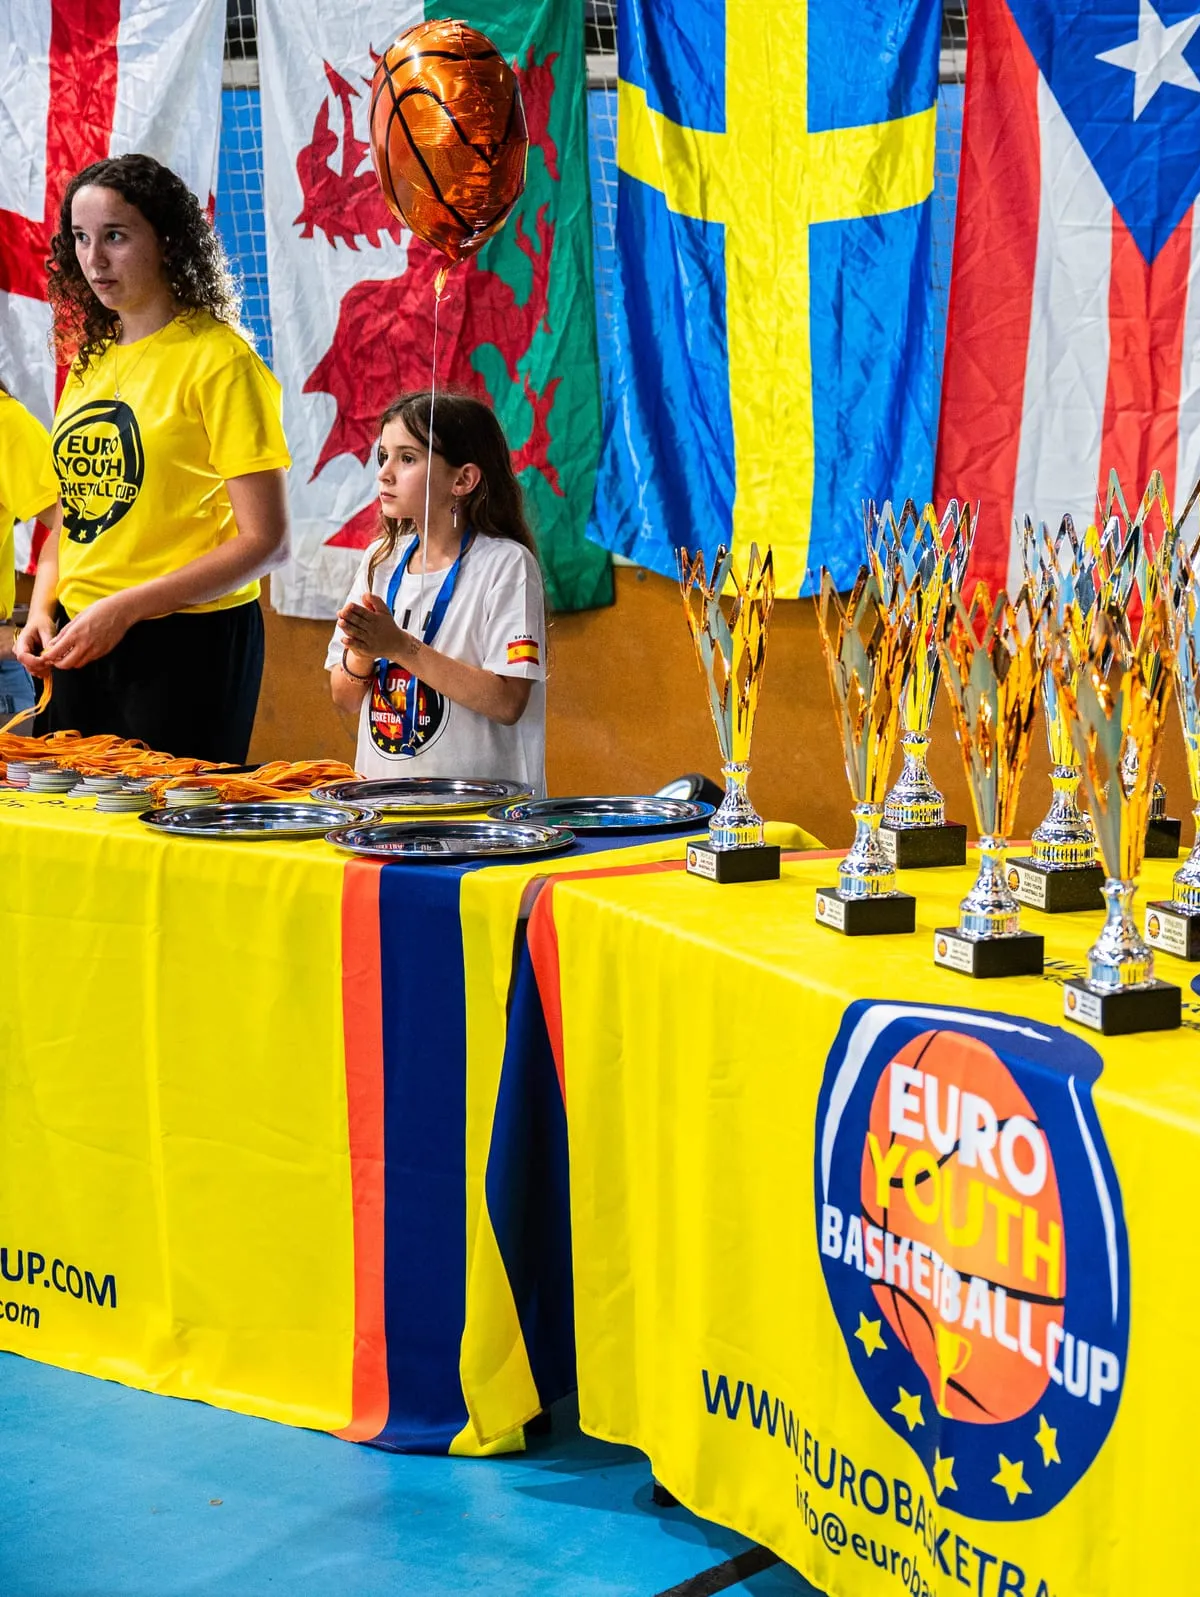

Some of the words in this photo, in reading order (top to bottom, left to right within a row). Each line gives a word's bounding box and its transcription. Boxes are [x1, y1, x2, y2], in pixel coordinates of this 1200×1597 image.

[67, 435, 119, 456] EURO
[418, 715, 431, 726] UP
[888, 1062, 1048, 1197] EURO
[867, 1131, 1061, 1300] YOUTH
[821, 1202, 1042, 1368] BASKETBALL
[1045, 1320, 1120, 1407] CUP
